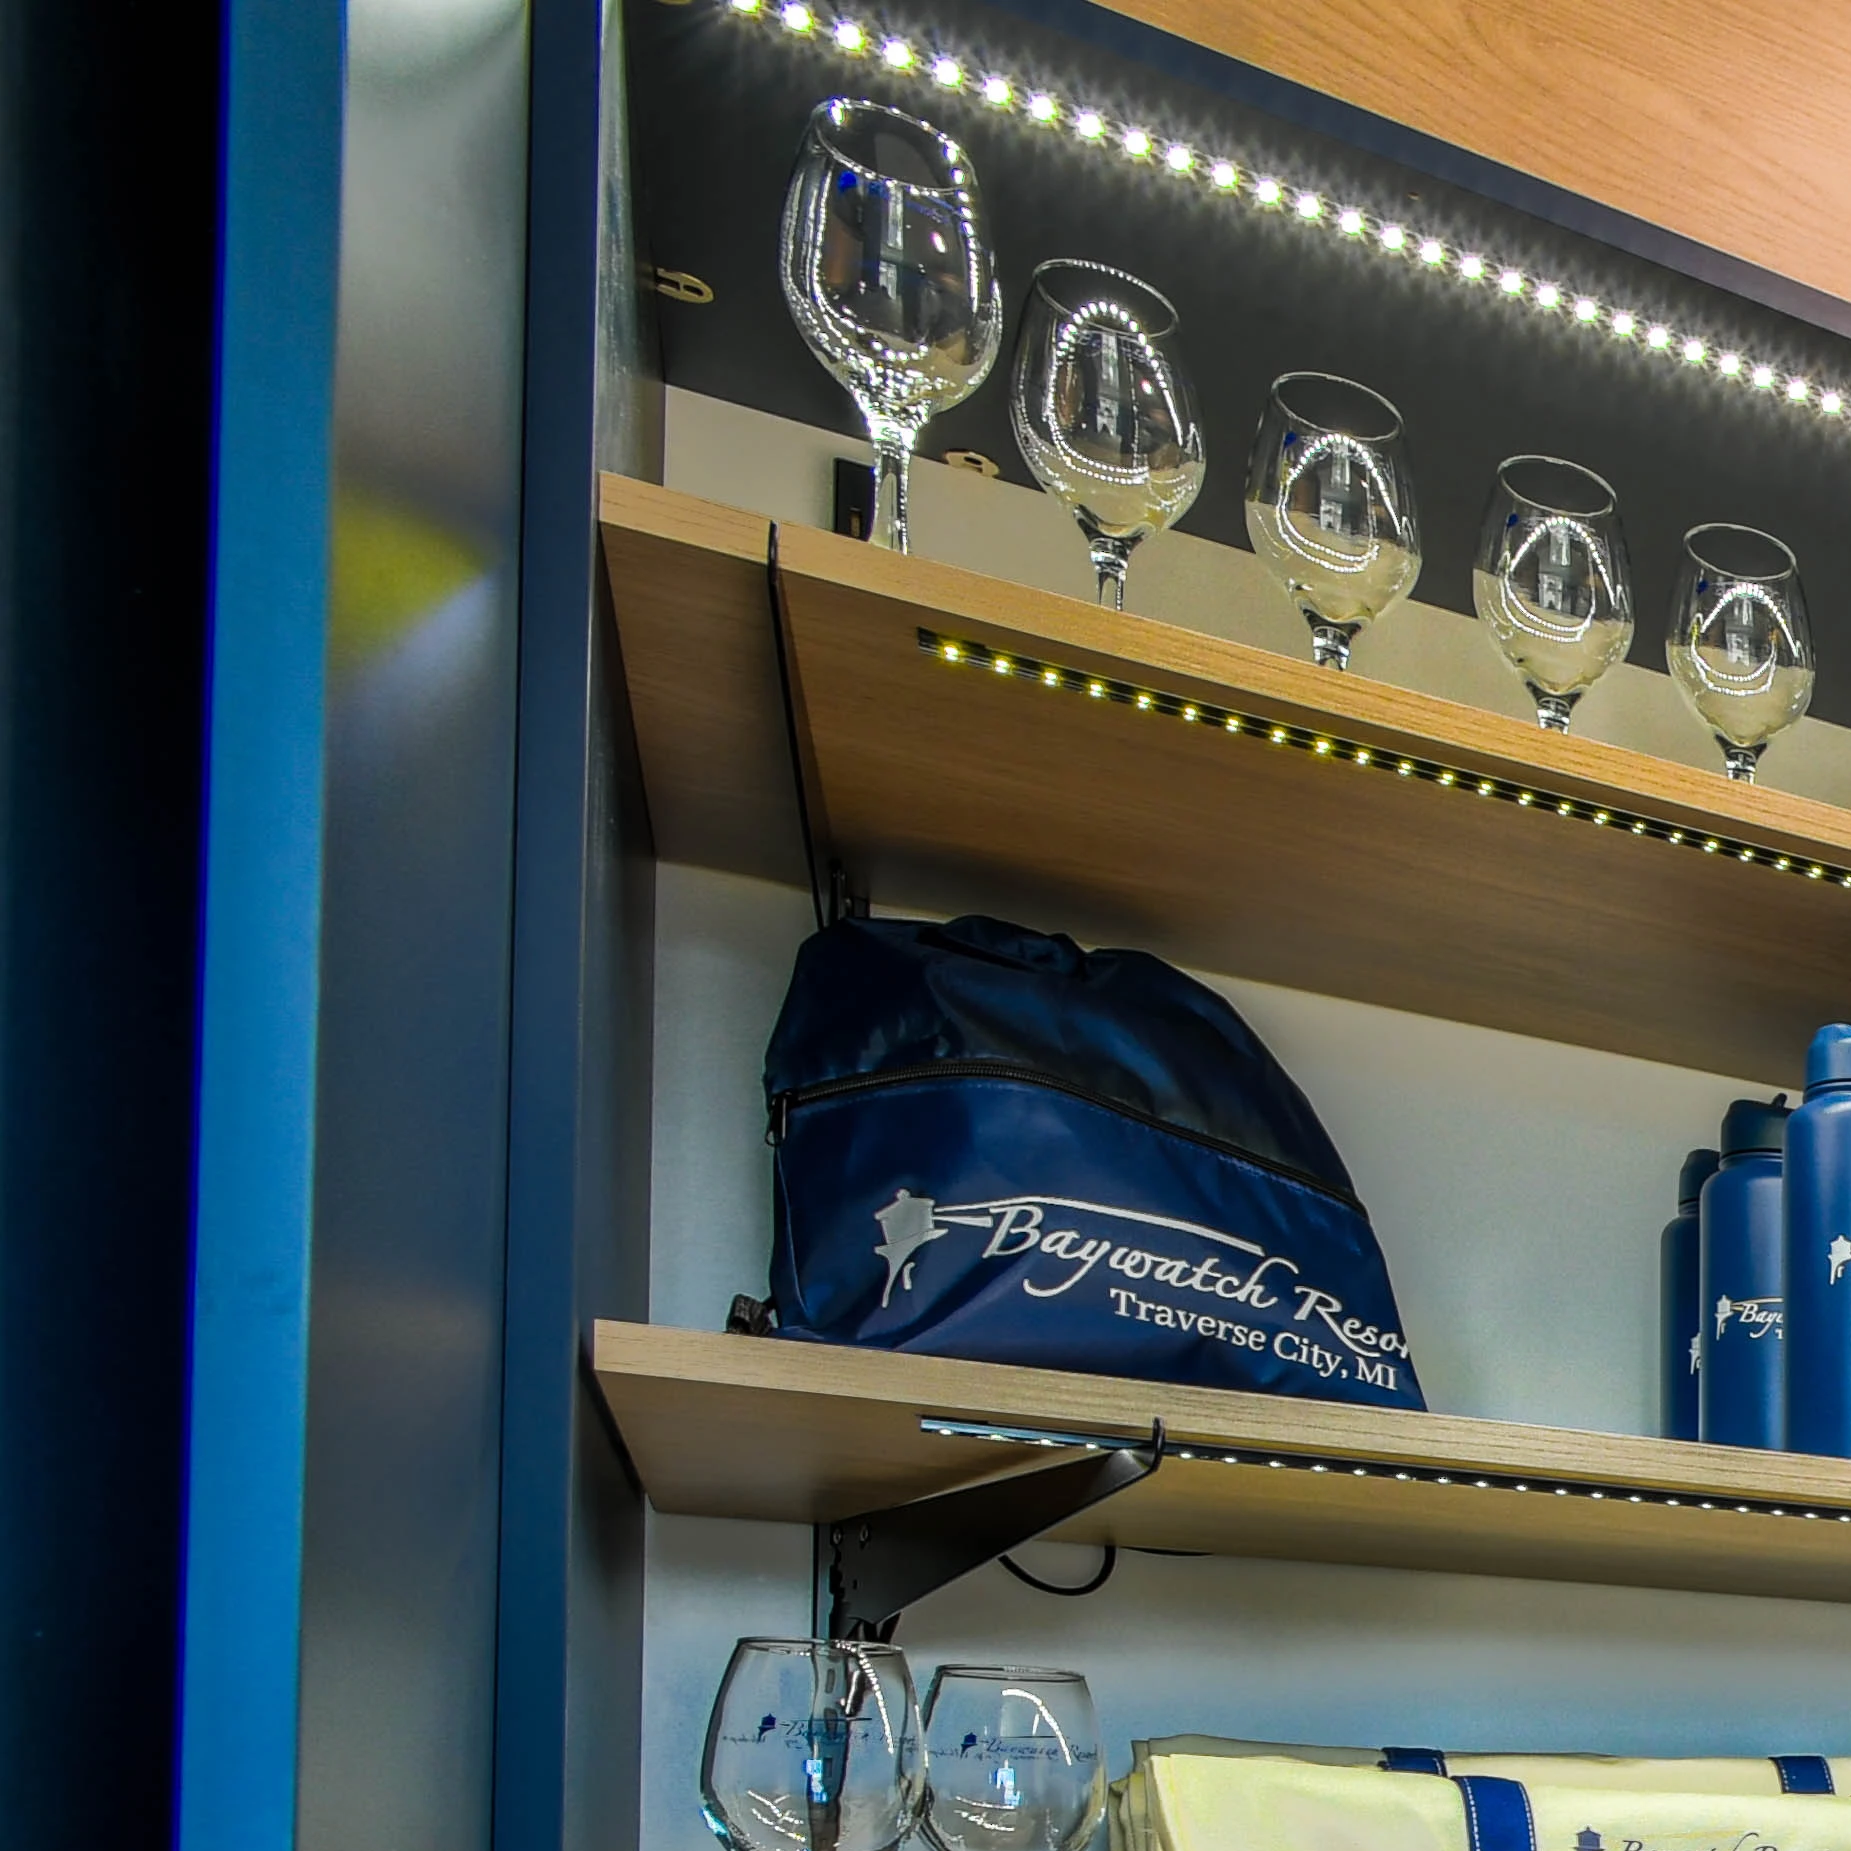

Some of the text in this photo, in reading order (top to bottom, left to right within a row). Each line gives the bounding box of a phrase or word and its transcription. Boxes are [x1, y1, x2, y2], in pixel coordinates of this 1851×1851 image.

[982, 1204, 1299, 1312] Baywatch
[1109, 1287, 1398, 1391] Traverse City, MI
